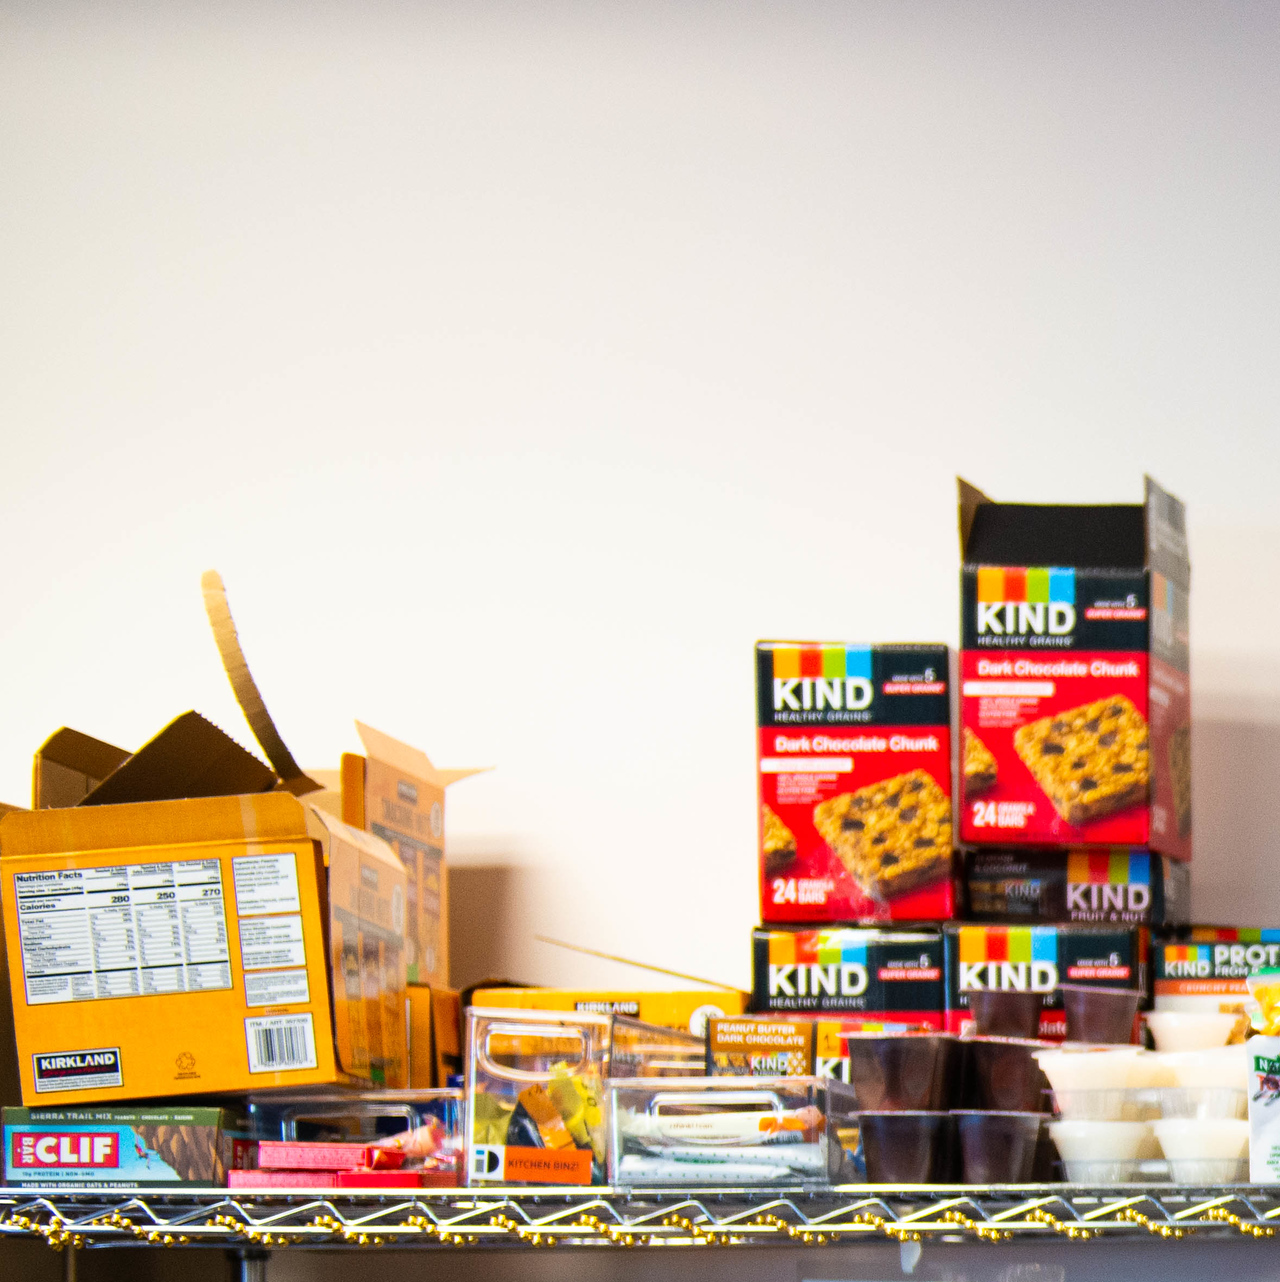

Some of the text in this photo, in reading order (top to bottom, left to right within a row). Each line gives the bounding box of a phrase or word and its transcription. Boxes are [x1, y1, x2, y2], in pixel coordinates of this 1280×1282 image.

[977, 601, 1076, 634] KIND
[977, 636, 1026, 647] HEALTHY
[977, 660, 1139, 677] Dark Chocolate Chunk
[773, 677, 874, 711] KIND
[774, 712, 823, 722] HEALTHY
[775, 735, 940, 752] Dark Chocolate Chunk
[973, 801, 996, 827] 24
[16, 871, 83, 883] Nutrition Facts
[20, 888, 221, 911] Calories 280 250 270
[773, 879, 796, 905] 24
[1066, 883, 1149, 911] KIND
[1070, 911, 1148, 923] FRUIT NUT
[959, 961, 1060, 993] KIND
[1165, 960, 1210, 977] KIND
[769, 963, 868, 996] KIND
[769, 997, 818, 1008] HEALTHY
[717, 1023, 796, 1035] PEANUT BUTTER
[717, 1034, 805, 1046] DARK CHOCOLATE
[41, 1053, 116, 1071] KIRKLAND
[751, 1056, 788, 1070] KIND
[30, 1112, 112, 1121] SIERRA TRAIL MIX
[21, 1136, 113, 1164] BAR CLIF
[508, 1159, 551, 1170] KITCHEN
